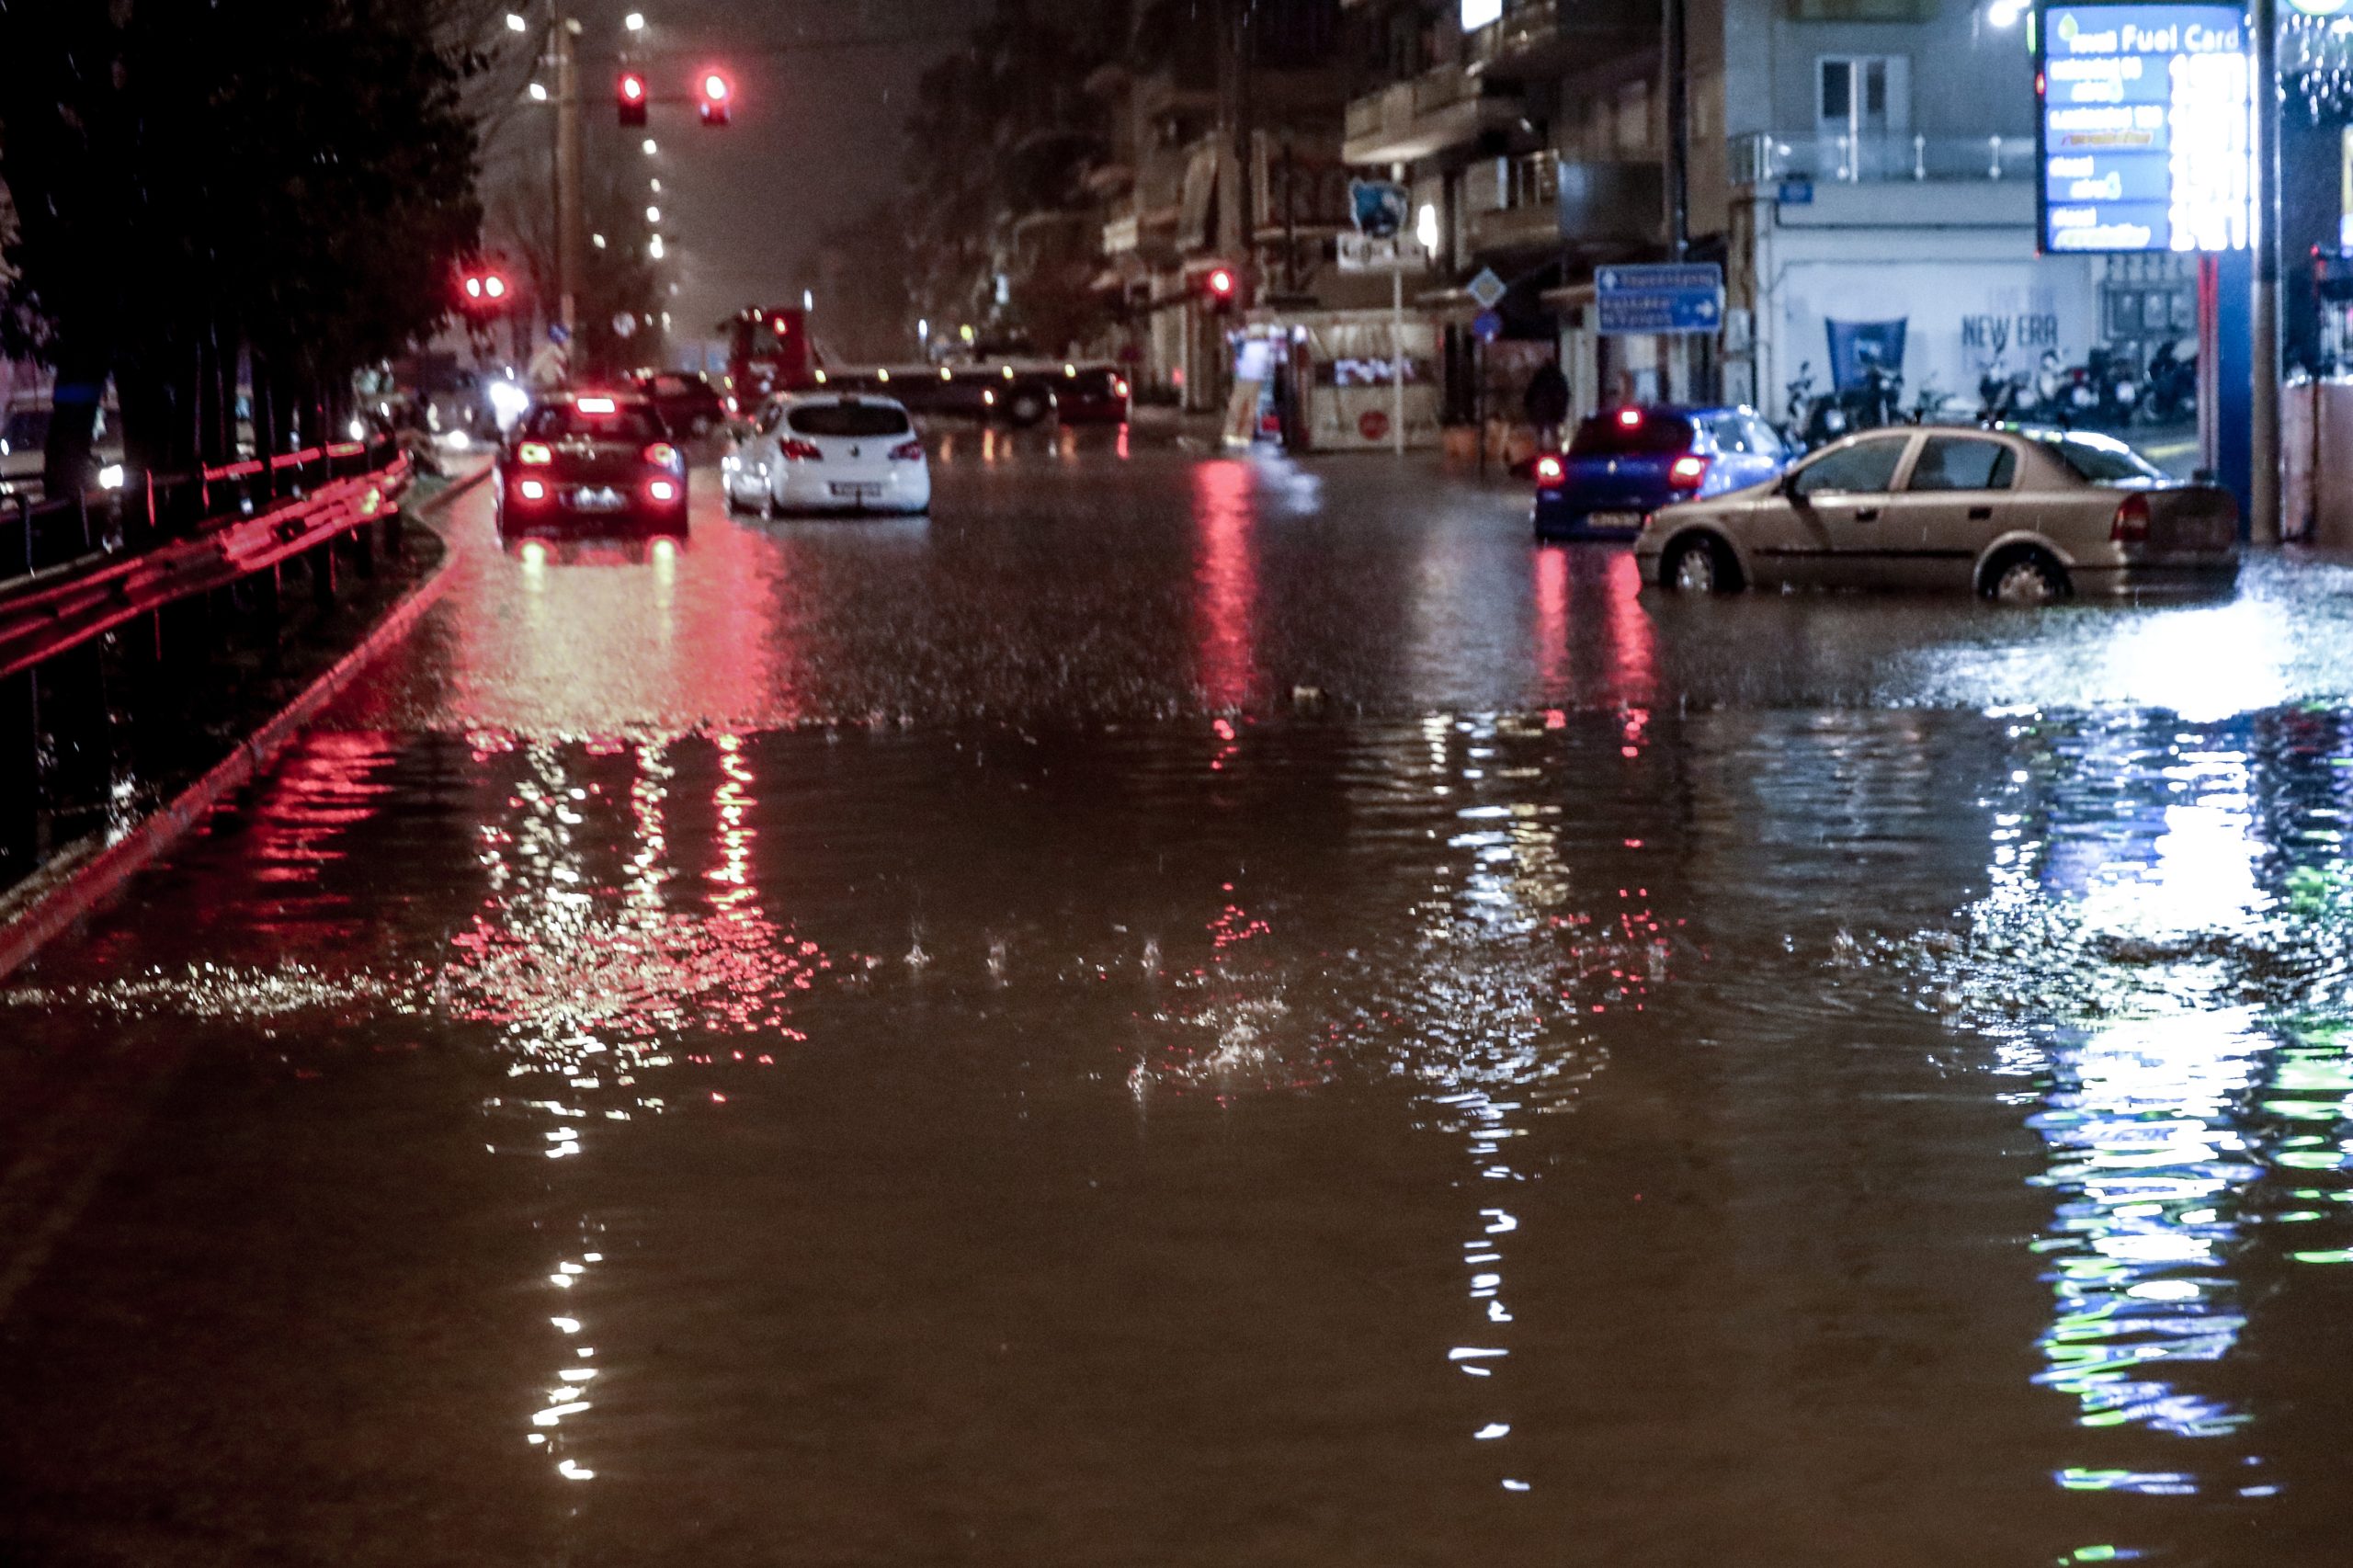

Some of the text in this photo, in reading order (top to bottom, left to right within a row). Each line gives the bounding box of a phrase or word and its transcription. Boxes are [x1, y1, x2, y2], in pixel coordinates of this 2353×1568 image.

[2121, 23, 2177, 51] Fuel
[2184, 23, 2240, 52] Card
[1961, 314, 2058, 348] NEW ERA
